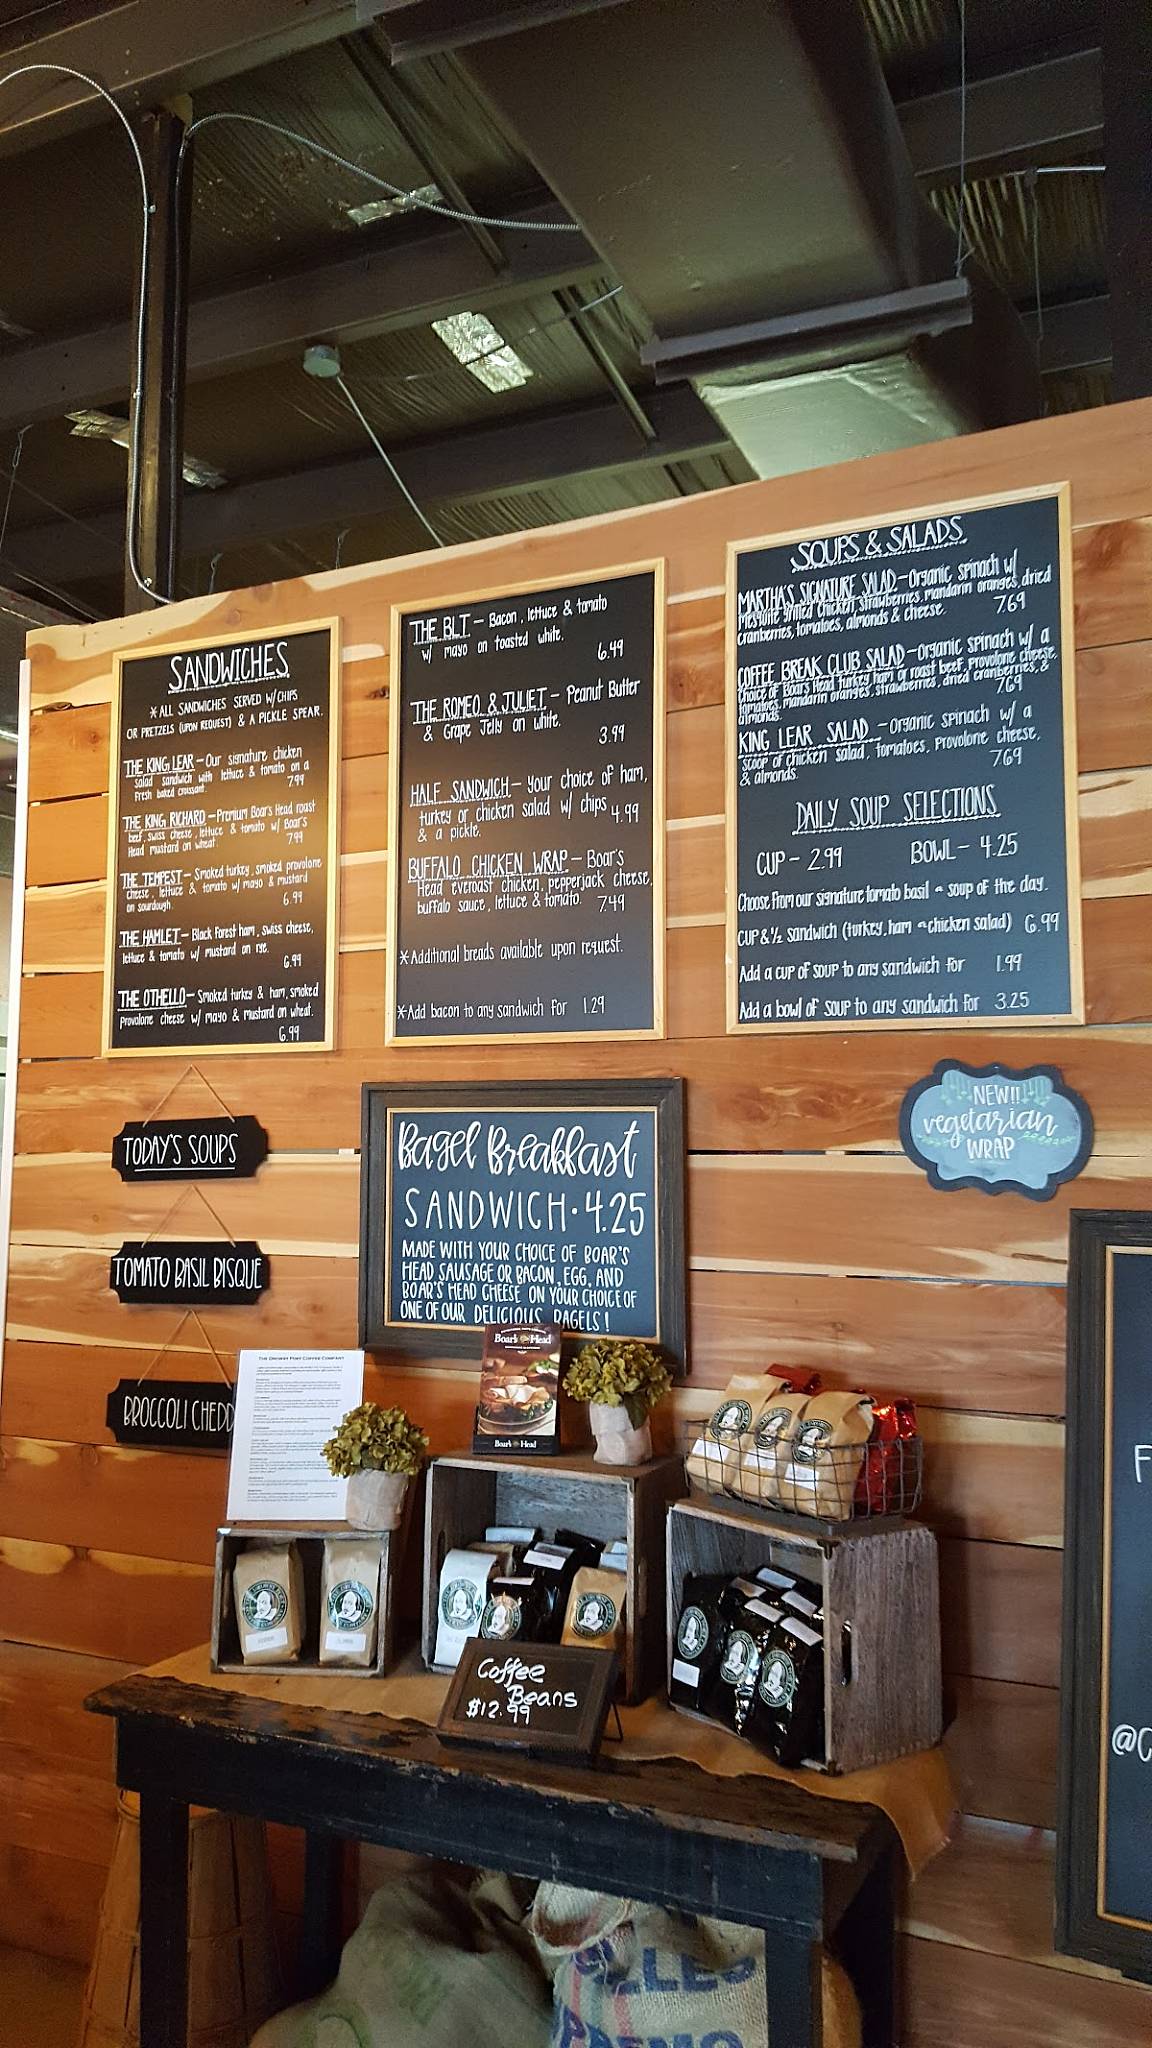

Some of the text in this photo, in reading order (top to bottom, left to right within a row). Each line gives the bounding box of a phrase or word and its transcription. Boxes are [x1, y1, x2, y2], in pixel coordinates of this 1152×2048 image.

[791, 516, 963, 569] SOUPS & SALADS
[410, 618, 437, 643] THE
[444, 614, 471, 637] BLT
[528, 601, 557, 621] lettuce
[563, 602, 572, 616] &
[577, 594, 607, 615] tomato
[846, 613, 889, 630] almonds
[891, 609, 900, 622] &
[422, 626, 564, 664] w/ mayo on toasted white.
[598, 639, 623, 660] 6.49
[169, 642, 289, 691] SANDWICHES
[178, 698, 226, 716] SANDWICHES
[234, 694, 261, 709] SERVED
[410, 699, 437, 723] THE
[443, 695, 480, 719] ROMEO
[488, 693, 497, 713] &
[501, 688, 547, 712] JULIET
[567, 678, 603, 704] Peanut
[609, 680, 640, 697] Butter
[127, 706, 323, 739] OR PRETZELS (UPON REQUEST) & A PICKLE SPEAR.
[423, 711, 561, 744] & Grape Jelly on white.
[599, 724, 625, 744] 3.99
[157, 787, 174, 798] baked
[796, 784, 997, 831] DAILY SOUP SELECTIONS
[409, 856, 460, 881] BUFFALO
[472, 853, 522, 877] CHICKEN
[533, 850, 568, 874] WRAP
[588, 849, 624, 868] Boar's
[756, 850, 785, 876] CUP
[807, 847, 842, 870] 2.99
[911, 839, 956, 864] BOWL
[980, 832, 1018, 859] 4.25
[597, 894, 625, 912] 7.49
[284, 954, 301, 968] 6.99
[464, 943, 494, 962] breads
[500, 939, 542, 960] available
[551, 940, 576, 960] upon
[582, 933, 623, 955] request.
[739, 963, 760, 982] Add
[765, 967, 772, 980] a
[842, 961, 853, 977] to
[857, 961, 879, 977] any
[882, 957, 939, 975] sandwich
[946, 958, 965, 974] for
[996, 954, 1022, 972] 1.99
[160, 1012, 184, 1025] cheese
[205, 1012, 227, 1024] mayo
[232, 1009, 239, 1021] &
[244, 1005, 274, 1020] mustard
[278, 1006, 286, 1017] on
[431, 1001, 460, 1018] bacon
[464, 1003, 473, 1017] to
[478, 1001, 493, 1019] any
[497, 997, 543, 1017] sandwich
[551, 1000, 567, 1016] for
[584, 996, 605, 1015] 1.29
[279, 1026, 300, 1042] 6.99
[973, 1085, 1020, 1106] NEW!!
[923, 1108, 1058, 1148] vegetarian
[123, 1133, 238, 1166] TODAY'S SOUPS
[399, 1120, 640, 1178] Bagel Breakfast
[967, 1137, 1015, 1160] WRAP
[405, 1187, 646, 1235] SANDWICH 4.25
[402, 1240, 630, 1265] MADE WITH YOUR CHOICE OF BOAR'S
[113, 1257, 262, 1289] TOMATO BASIL BISQUE
[402, 1262, 433, 1281] HEAD
[439, 1263, 494, 1283] SAUSAGE
[497, 1265, 511, 1283] OR
[596, 1268, 623, 1287] AND
[403, 1281, 637, 1308] BOAR'S HEAD CHEESE ON YOUR CHOICE OF
[400, 1301, 422, 1319] ONE
[426, 1302, 439, 1320] OF
[442, 1304, 465, 1322] OUR
[474, 1305, 543, 1324] DELICIOUS
[530, 1334, 551, 1344] Head
[124, 1396, 187, 1430] BROCCOLI
[478, 1656, 545, 1688] Coffee
[507, 1684, 577, 1708] Beans
[466, 1698, 530, 1725] $12.99
